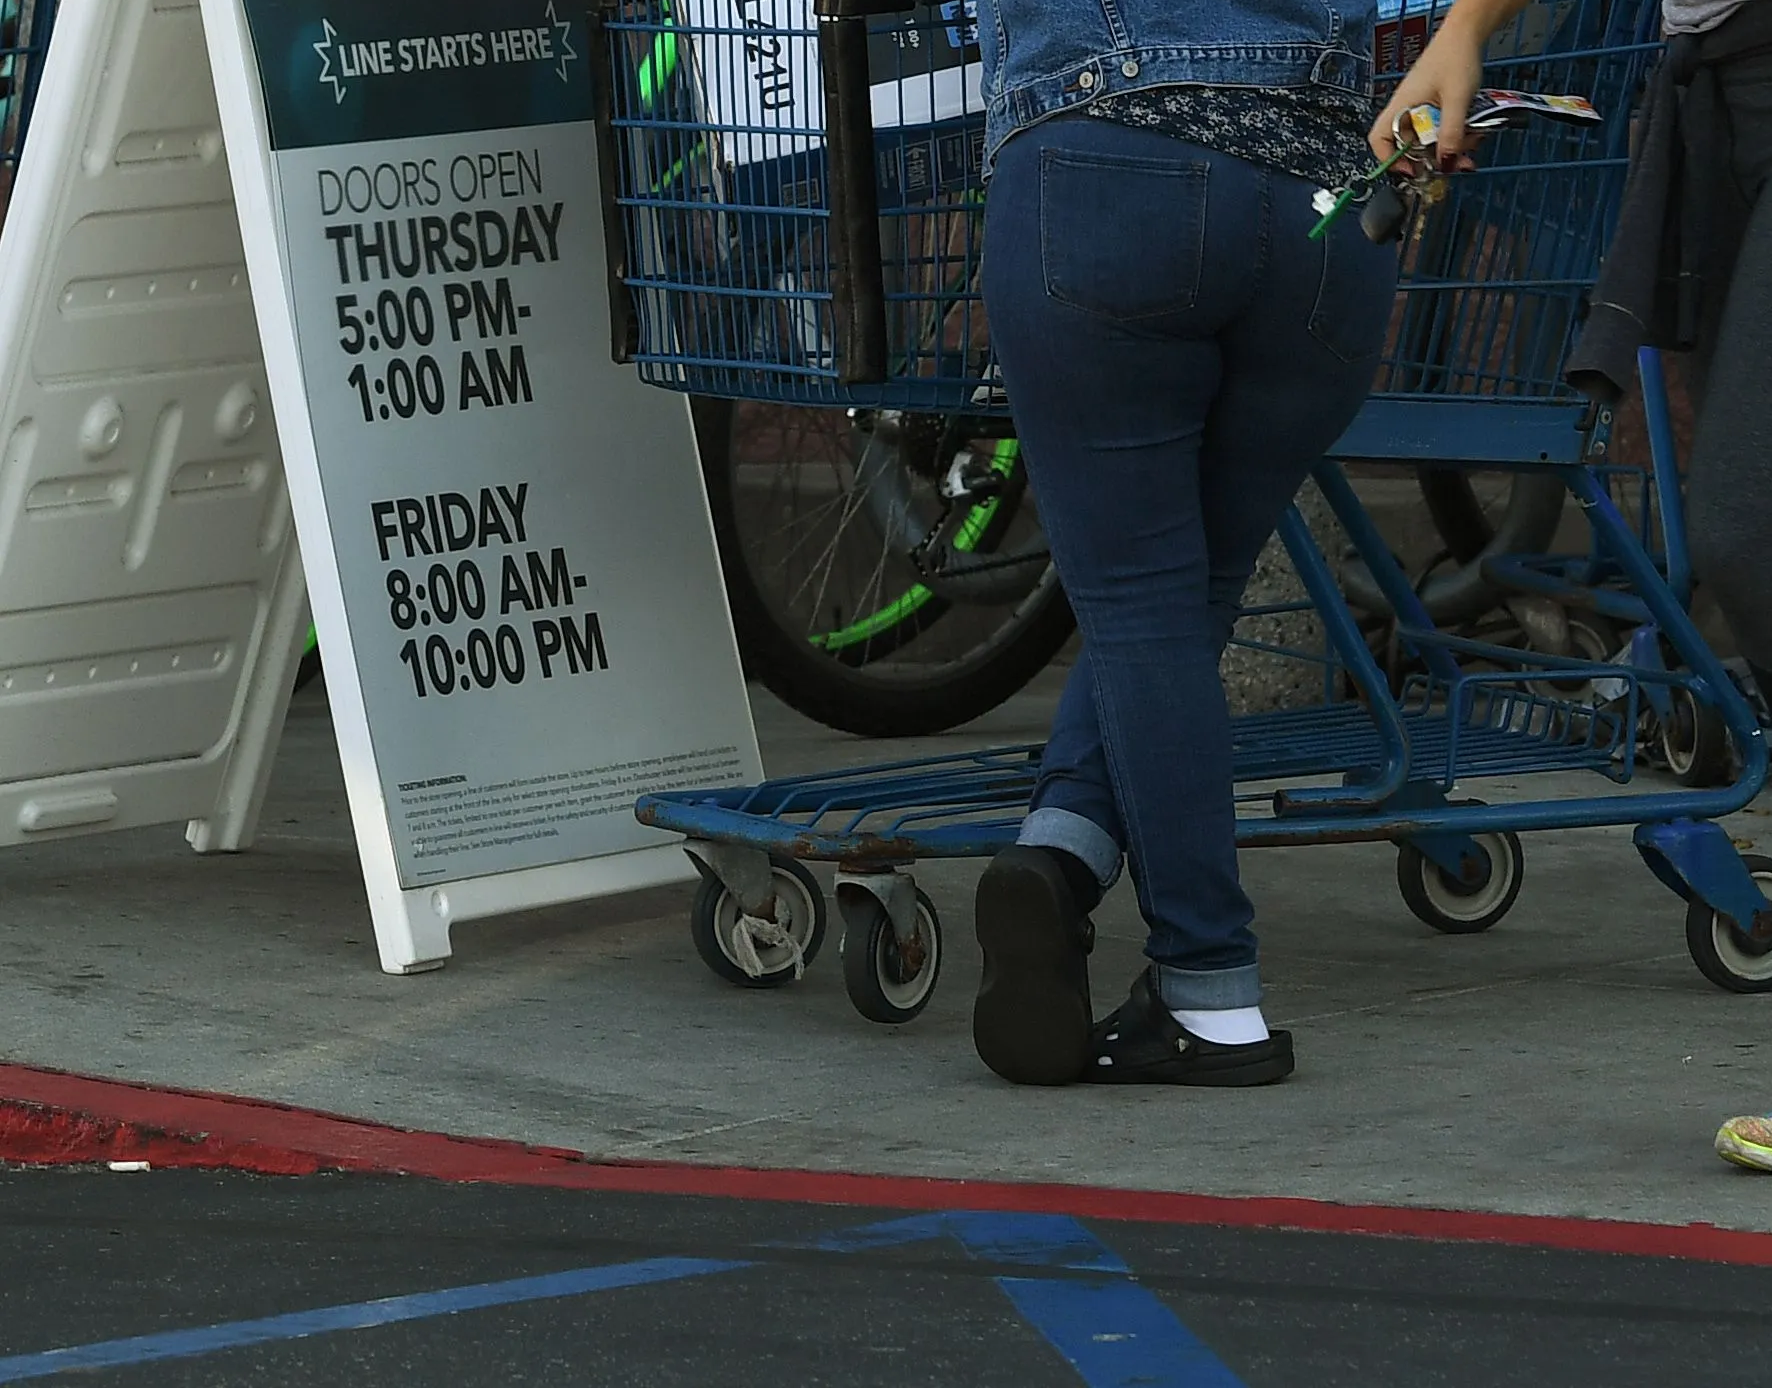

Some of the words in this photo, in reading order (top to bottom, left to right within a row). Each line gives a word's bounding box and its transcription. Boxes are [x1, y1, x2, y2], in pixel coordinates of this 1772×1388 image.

[338, 39, 394, 77] LINE
[398, 33, 487, 71] STARTS
[493, 27, 554, 63] HERE
[318, 159, 441, 216] DOORS
[450, 148, 542, 204] OPEN
[325, 202, 564, 284] THURSDAY
[337, 285, 434, 355] 5:00
[444, 277, 531, 342] PM-
[347, 356, 446, 423] 1:00
[459, 345, 534, 410] AM
[370, 482, 529, 561] FRIDAY
[386, 558, 486, 630] 8:00
[500, 547, 588, 616] AM-
[399, 623, 526, 698] 10:00
[533, 612, 610, 679] PM
